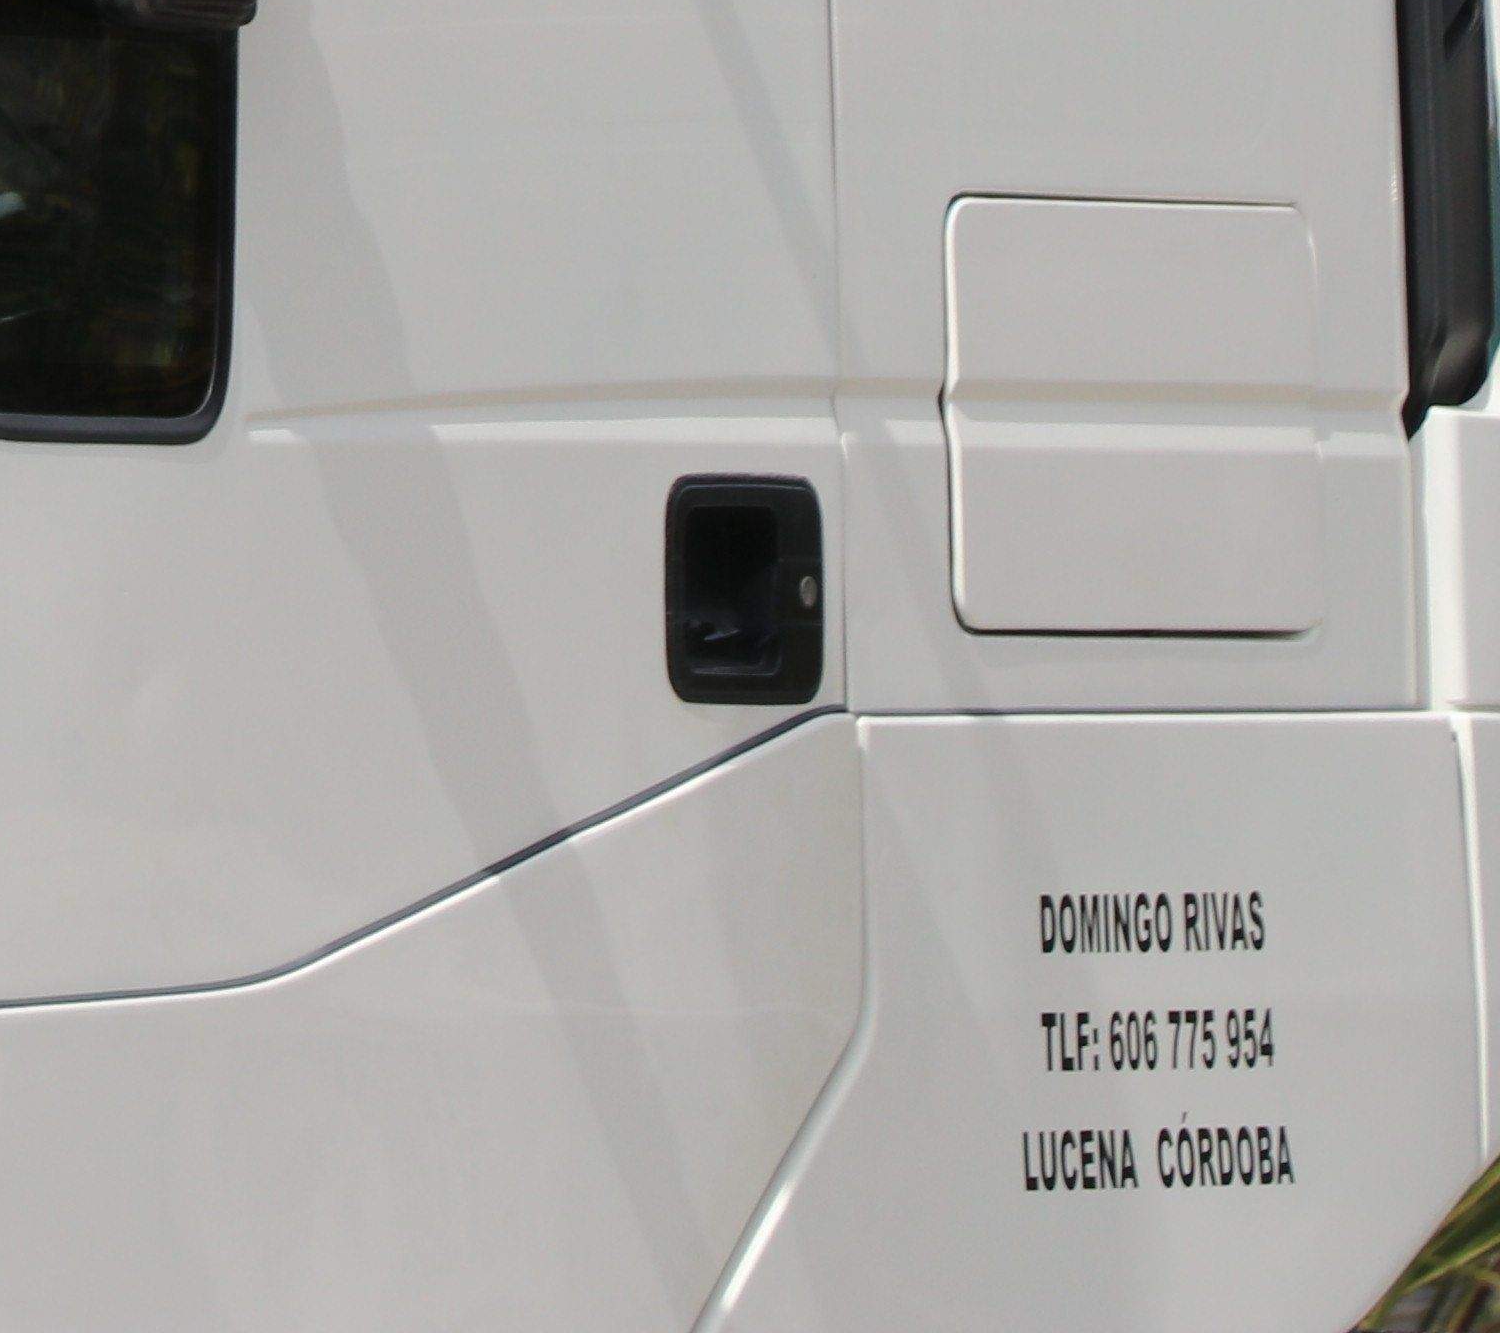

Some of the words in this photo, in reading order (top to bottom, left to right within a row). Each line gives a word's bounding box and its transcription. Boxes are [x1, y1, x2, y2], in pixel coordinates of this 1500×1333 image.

[1040, 892, 1172, 954] DOMINGO
[1182, 890, 1266, 951] RIVAS
[1041, 1011, 1100, 1072] TLF:
[1109, 1010, 1158, 1071] 606
[1167, 1009, 1216, 1070] 775
[1226, 1008, 1274, 1069] 954
[1023, 1129, 1139, 1192] LUCENA
[1157, 1112, 1296, 1189] CÓRDOBA
